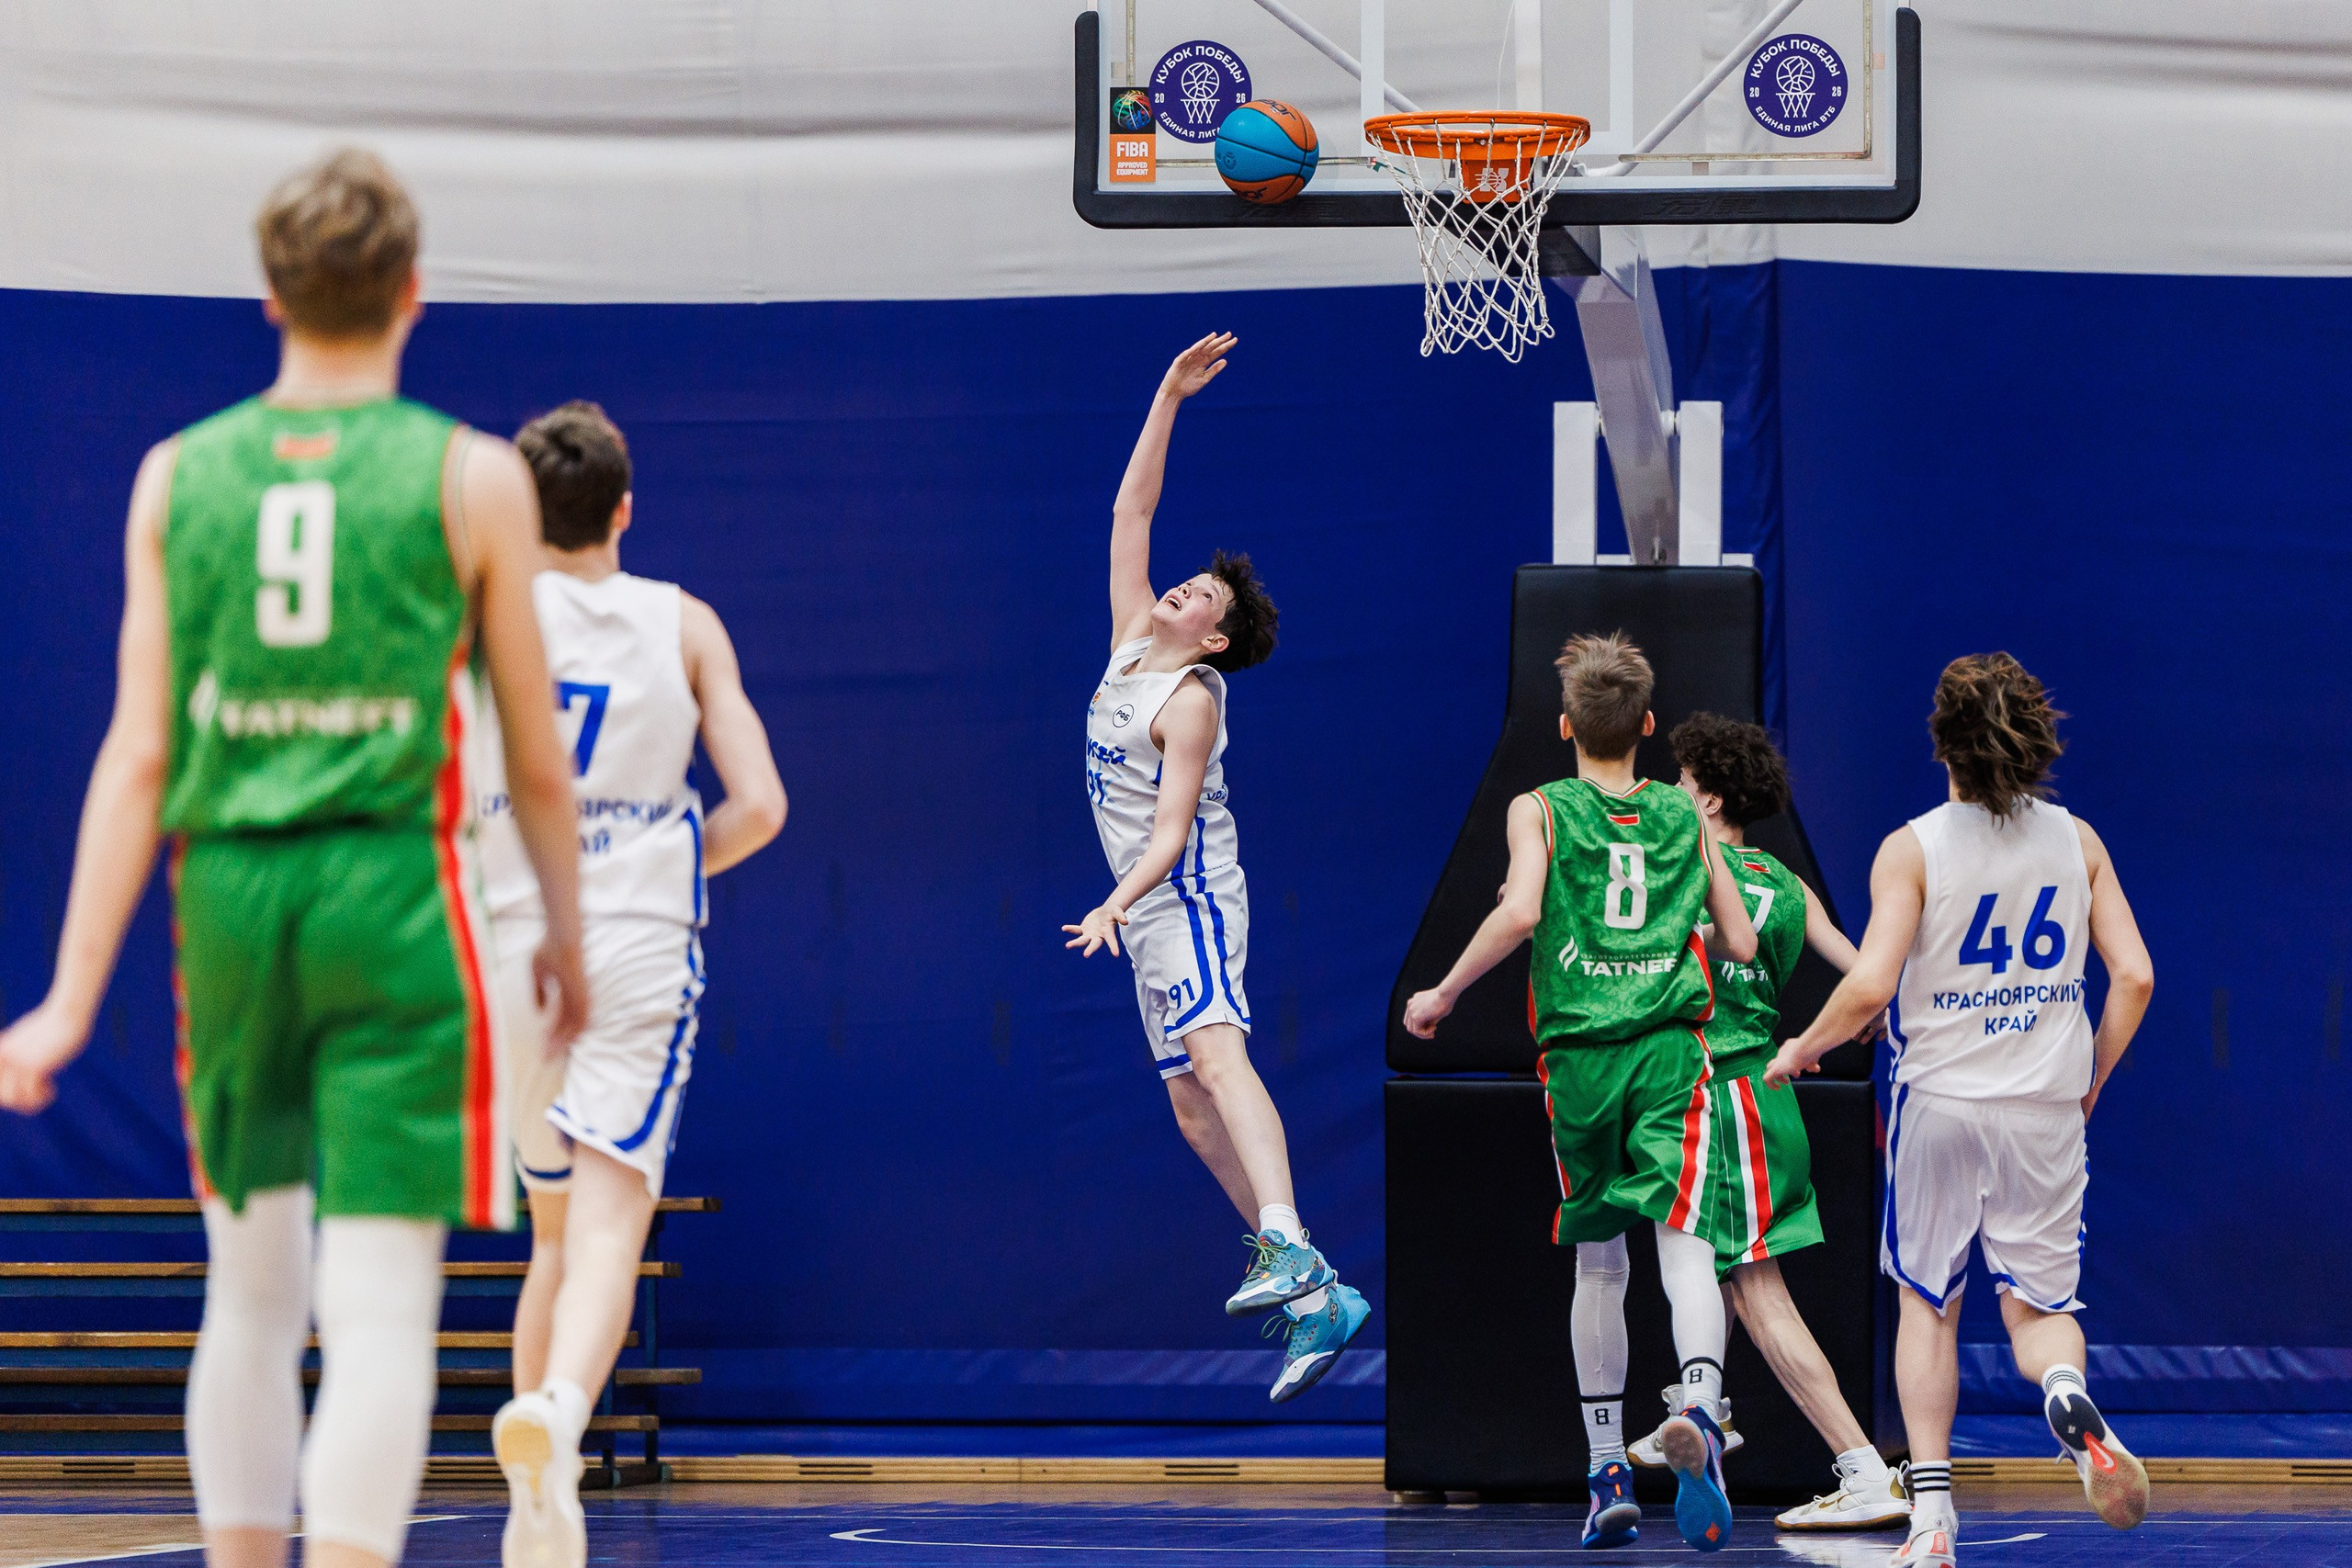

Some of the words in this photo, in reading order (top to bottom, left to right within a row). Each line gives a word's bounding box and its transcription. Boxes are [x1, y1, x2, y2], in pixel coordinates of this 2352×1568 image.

[1156, 47, 1193, 85] КУБОК
[1195, 45, 1245, 84] ПОБЕДЫ
[1750, 40, 1788, 78] КУБОК
[1790, 39, 1840, 77] ПОБЕДЫ
[1155, 93, 1165, 104] 20
[1236, 93, 1246, 104] 26
[1749, 86, 1759, 97] 20
[1831, 85, 1842, 96] 26
[1159, 111, 1195, 138] ЕДИНАЯ
[1755, 106, 1791, 132] ЕДИНАЯ
[1793, 120, 1820, 133] ЛИГА
[1819, 106, 1836, 123] ВТБ
[1116, 141, 1148, 157] FIBA
[1117, 161, 1148, 169] APPROVED
[256, 479, 336, 649] 9
[554, 681, 610, 777] 7
[1115, 709, 1130, 722] РФБ
[1604, 842, 1647, 930] 8
[1745, 883, 1775, 934] 7
[1959, 886, 2066, 975] 46
[1168, 977, 1196, 1010] 91
[1932, 978, 2082, 1011] КРАСНОЯРСКИЙ
[1984, 1010, 2038, 1036] КРАЙ
[1690, 1368, 1703, 1384] 8
[1594, 1408, 1610, 1425] 8
